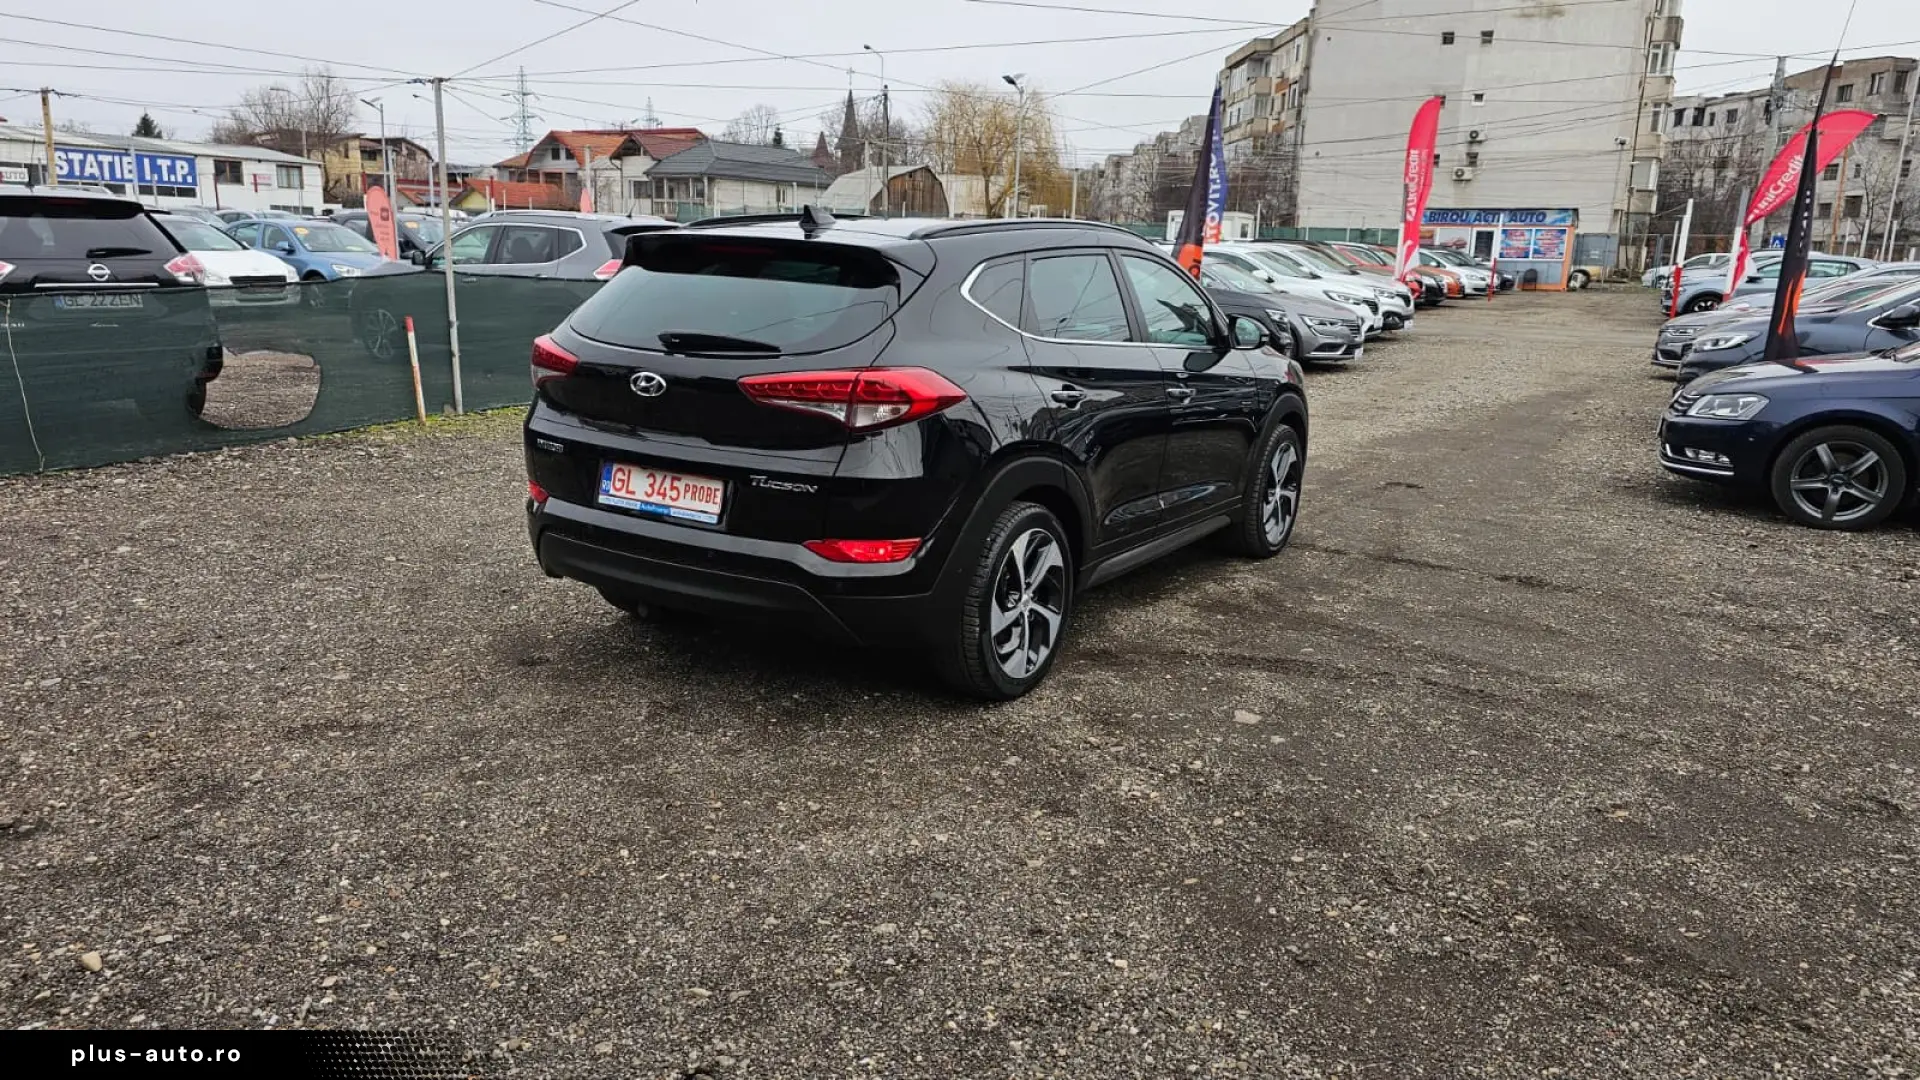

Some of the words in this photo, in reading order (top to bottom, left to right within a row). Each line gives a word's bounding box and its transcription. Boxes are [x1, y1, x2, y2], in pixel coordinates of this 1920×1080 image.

[56, 150, 134, 180] STATIE
[143, 157, 193, 183] I.T.P.
[1428, 210, 1470, 223] BIROU
[1509, 211, 1547, 223] AUTO
[612, 467, 636, 496] GL
[644, 472, 682, 502] 345
[684, 483, 720, 505] PROBE
